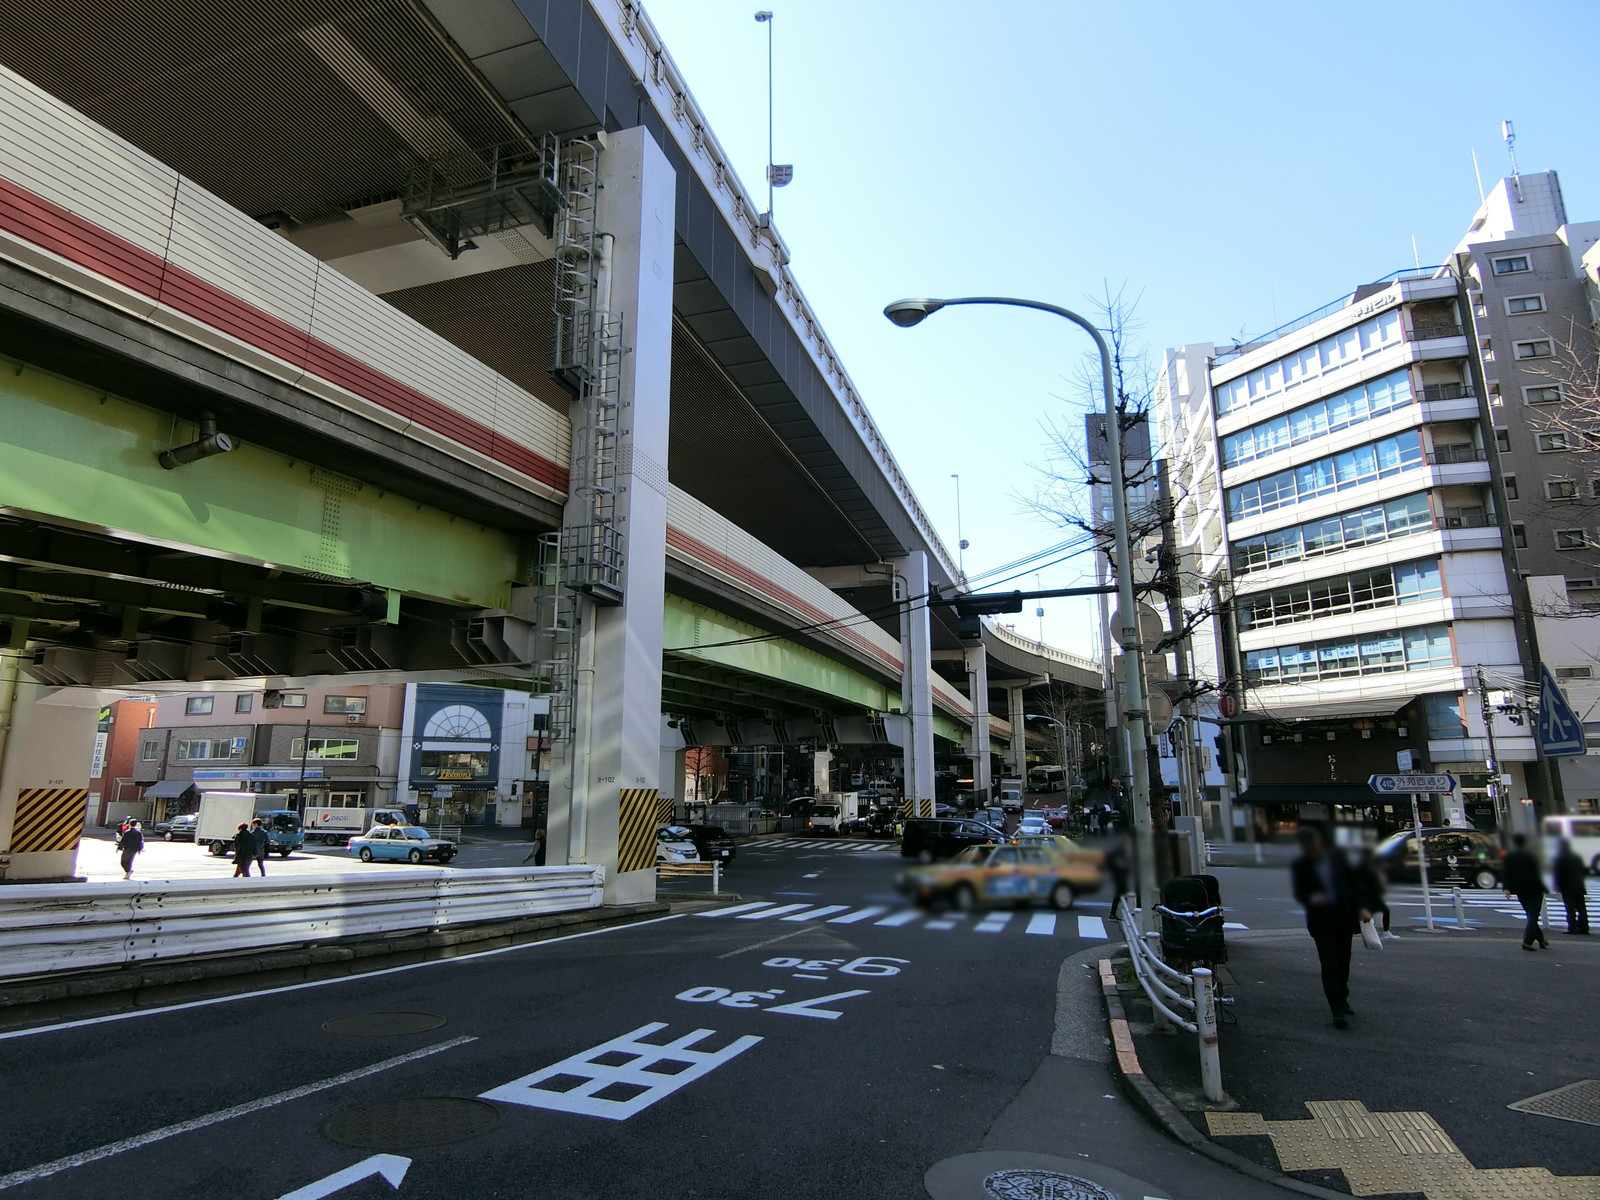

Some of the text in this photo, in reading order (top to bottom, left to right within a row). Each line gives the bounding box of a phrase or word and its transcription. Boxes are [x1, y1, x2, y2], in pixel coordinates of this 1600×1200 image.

[92, 734, 105, 776] 三井住友銀行
[1396, 776, 1446, 786] 外苑西通り
[331, 814, 349, 822] pepsi
